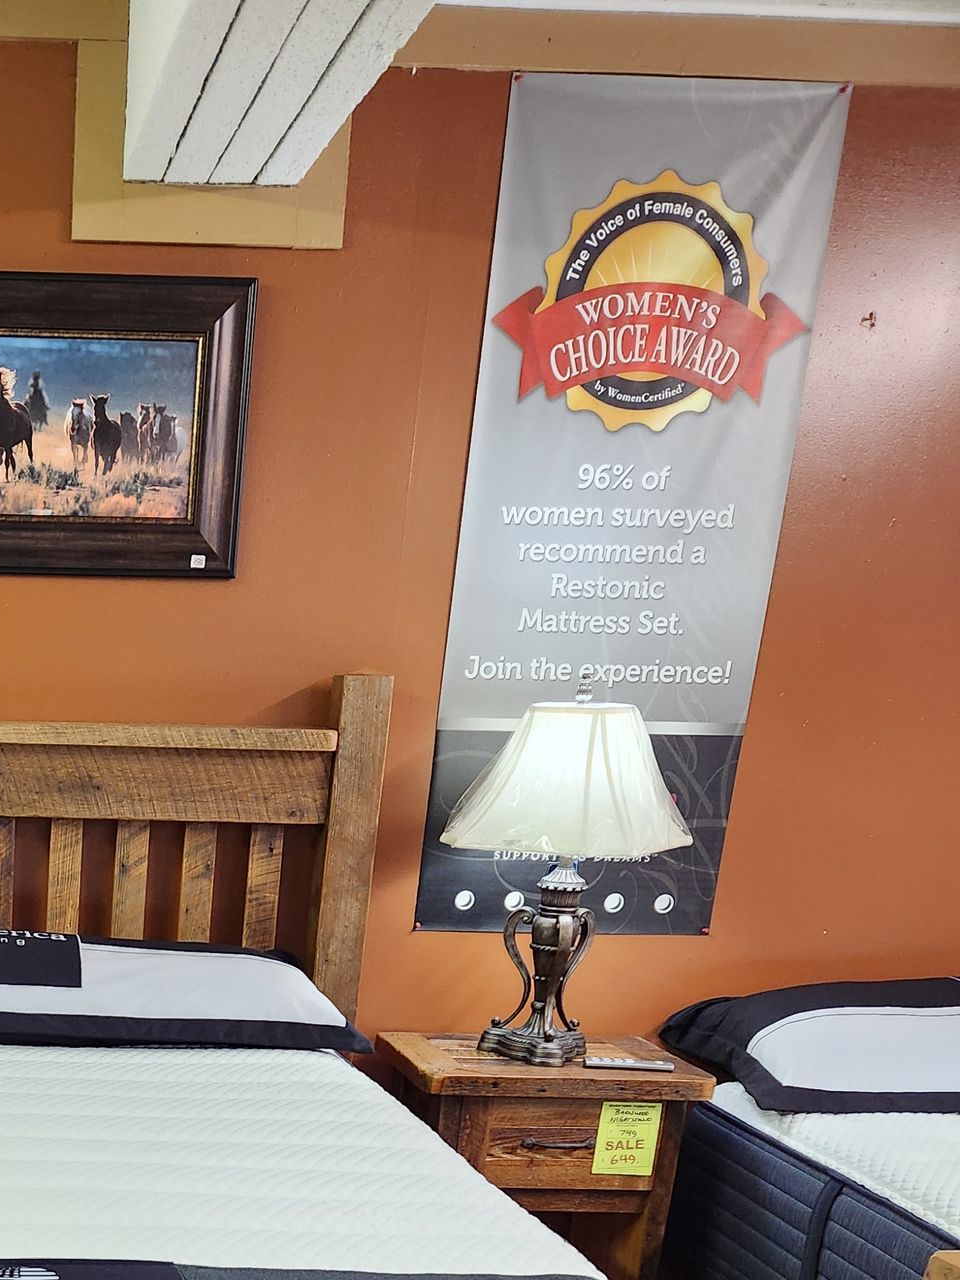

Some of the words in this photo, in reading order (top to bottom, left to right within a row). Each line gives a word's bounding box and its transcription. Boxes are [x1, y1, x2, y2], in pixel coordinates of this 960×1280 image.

[566, 250, 591, 282] The
[585, 213, 624, 251] Voice
[627, 204, 640, 222] of
[643, 200, 694, 219] Female
[694, 209, 743, 288] Consumers
[575, 291, 722, 330] WOMEN'S
[549, 324, 649, 383] CHOICE
[650, 326, 741, 386] AWARD
[594, 380, 607, 395] by
[576, 463, 635, 492] 96%
[641, 464, 673, 492] of
[501, 504, 604, 528] women
[610, 503, 736, 535] surveyed
[518, 539, 685, 565] recommend
[690, 545, 707, 566] a
[550, 573, 666, 601] Restonic
[517, 608, 632, 635] Mattress
[637, 610, 685, 637] Set.
[464, 655, 522, 683] Join
[529, 656, 572, 682] the
[579, 659, 734, 689] experience!
[605, 1139, 646, 1151] SALE
